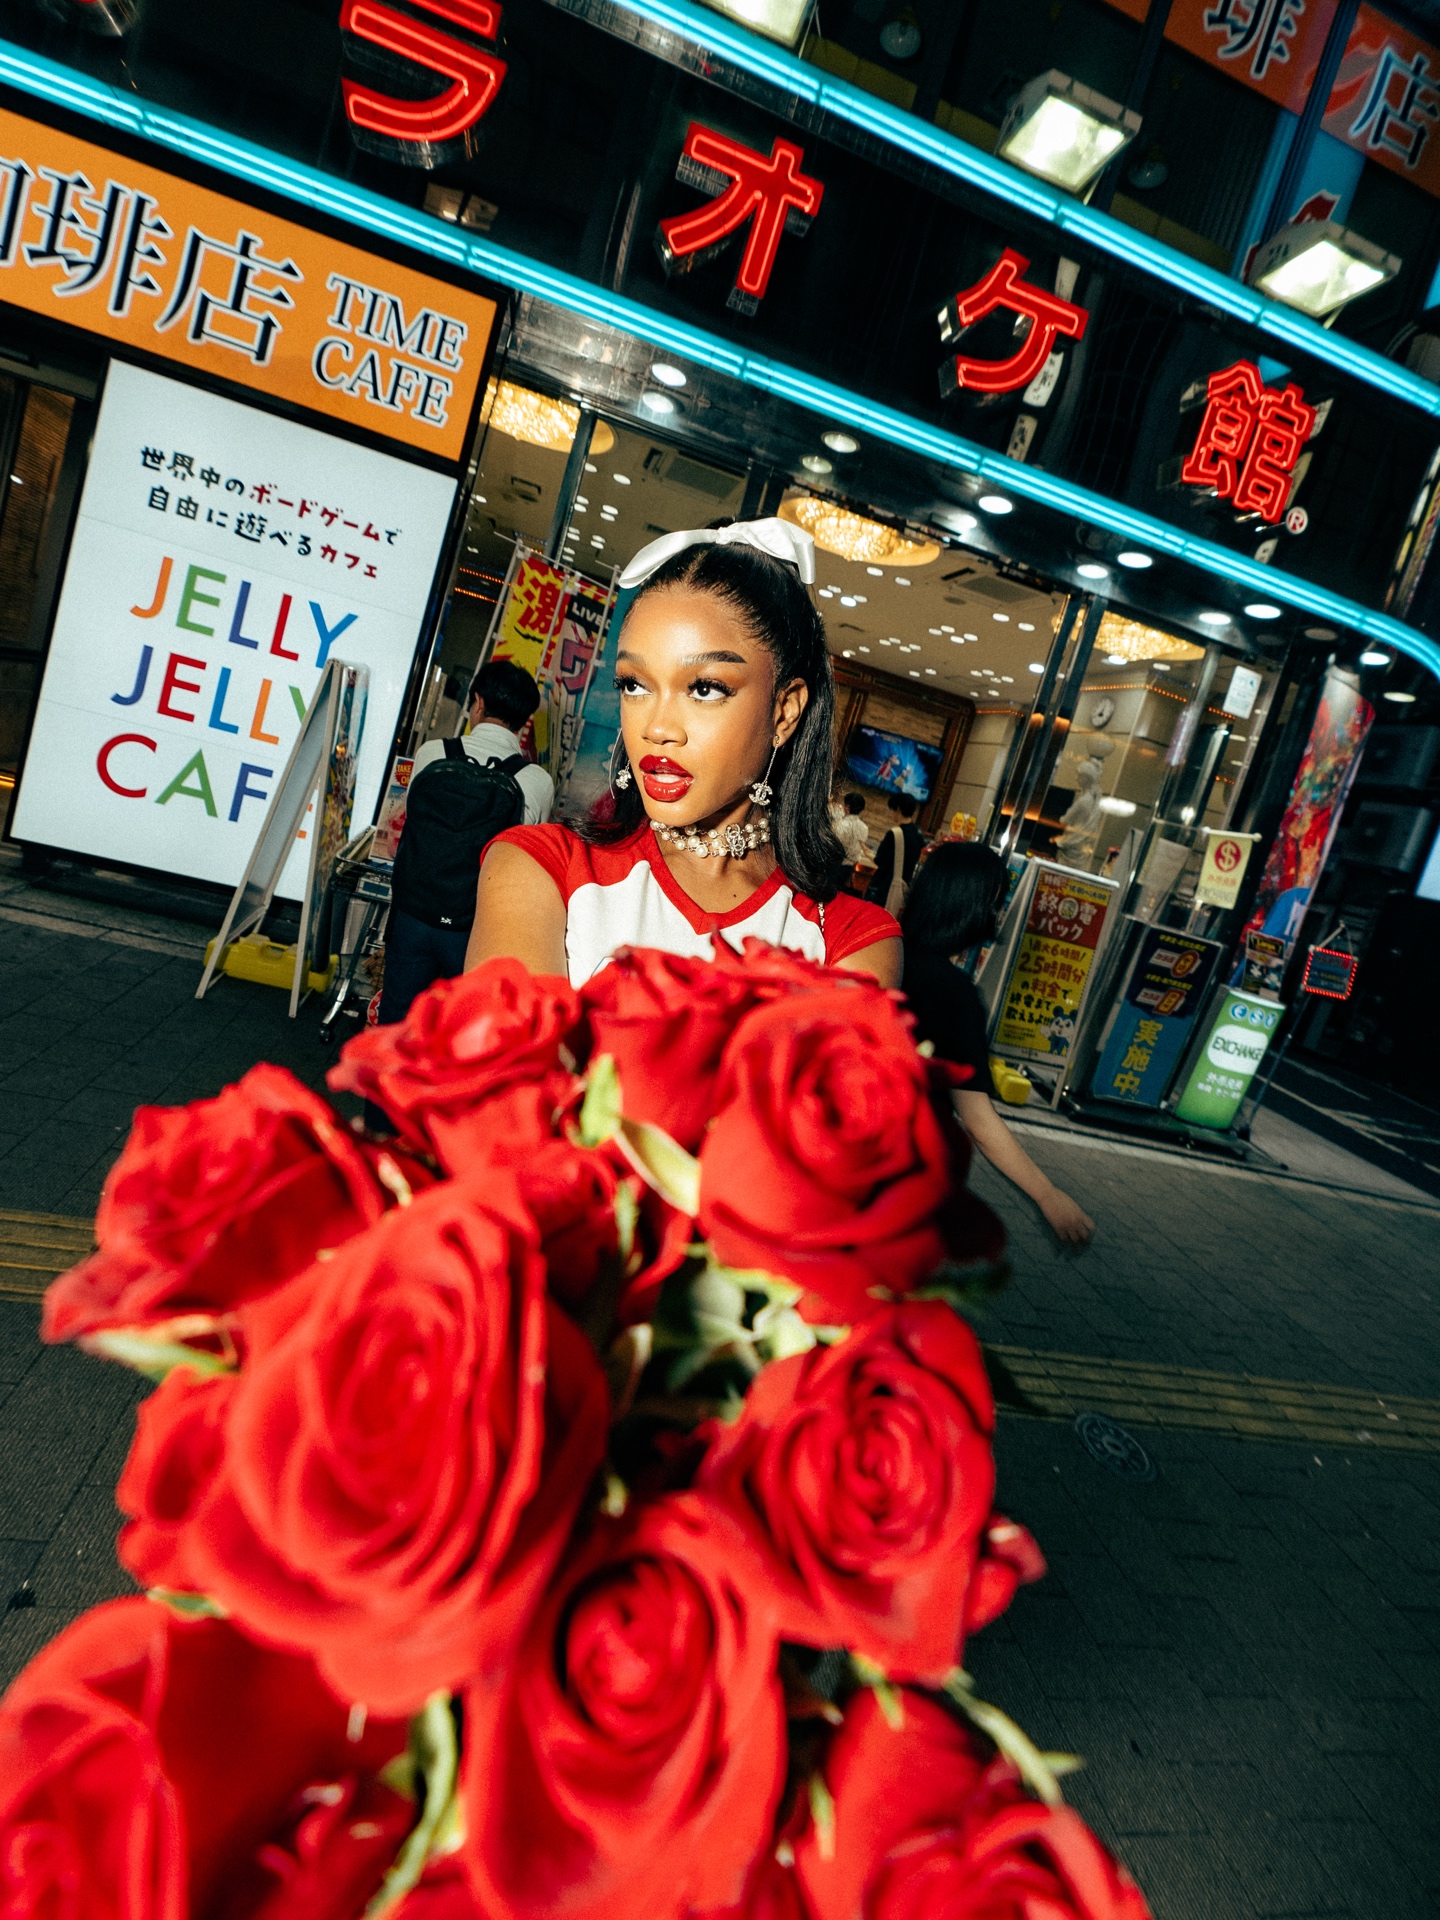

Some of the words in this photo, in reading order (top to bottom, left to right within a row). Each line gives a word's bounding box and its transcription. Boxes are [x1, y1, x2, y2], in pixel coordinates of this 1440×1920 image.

[326, 273, 468, 371] TIME
[313, 335, 453, 428] CAFE
[141, 446, 402, 545] 世界中のボードゲームで
[148, 485, 378, 579] 自由に遊べるカフェ
[130, 556, 359, 669] JELLY
[96, 733, 313, 840] CAF
[1038, 915, 1083, 941] パック
